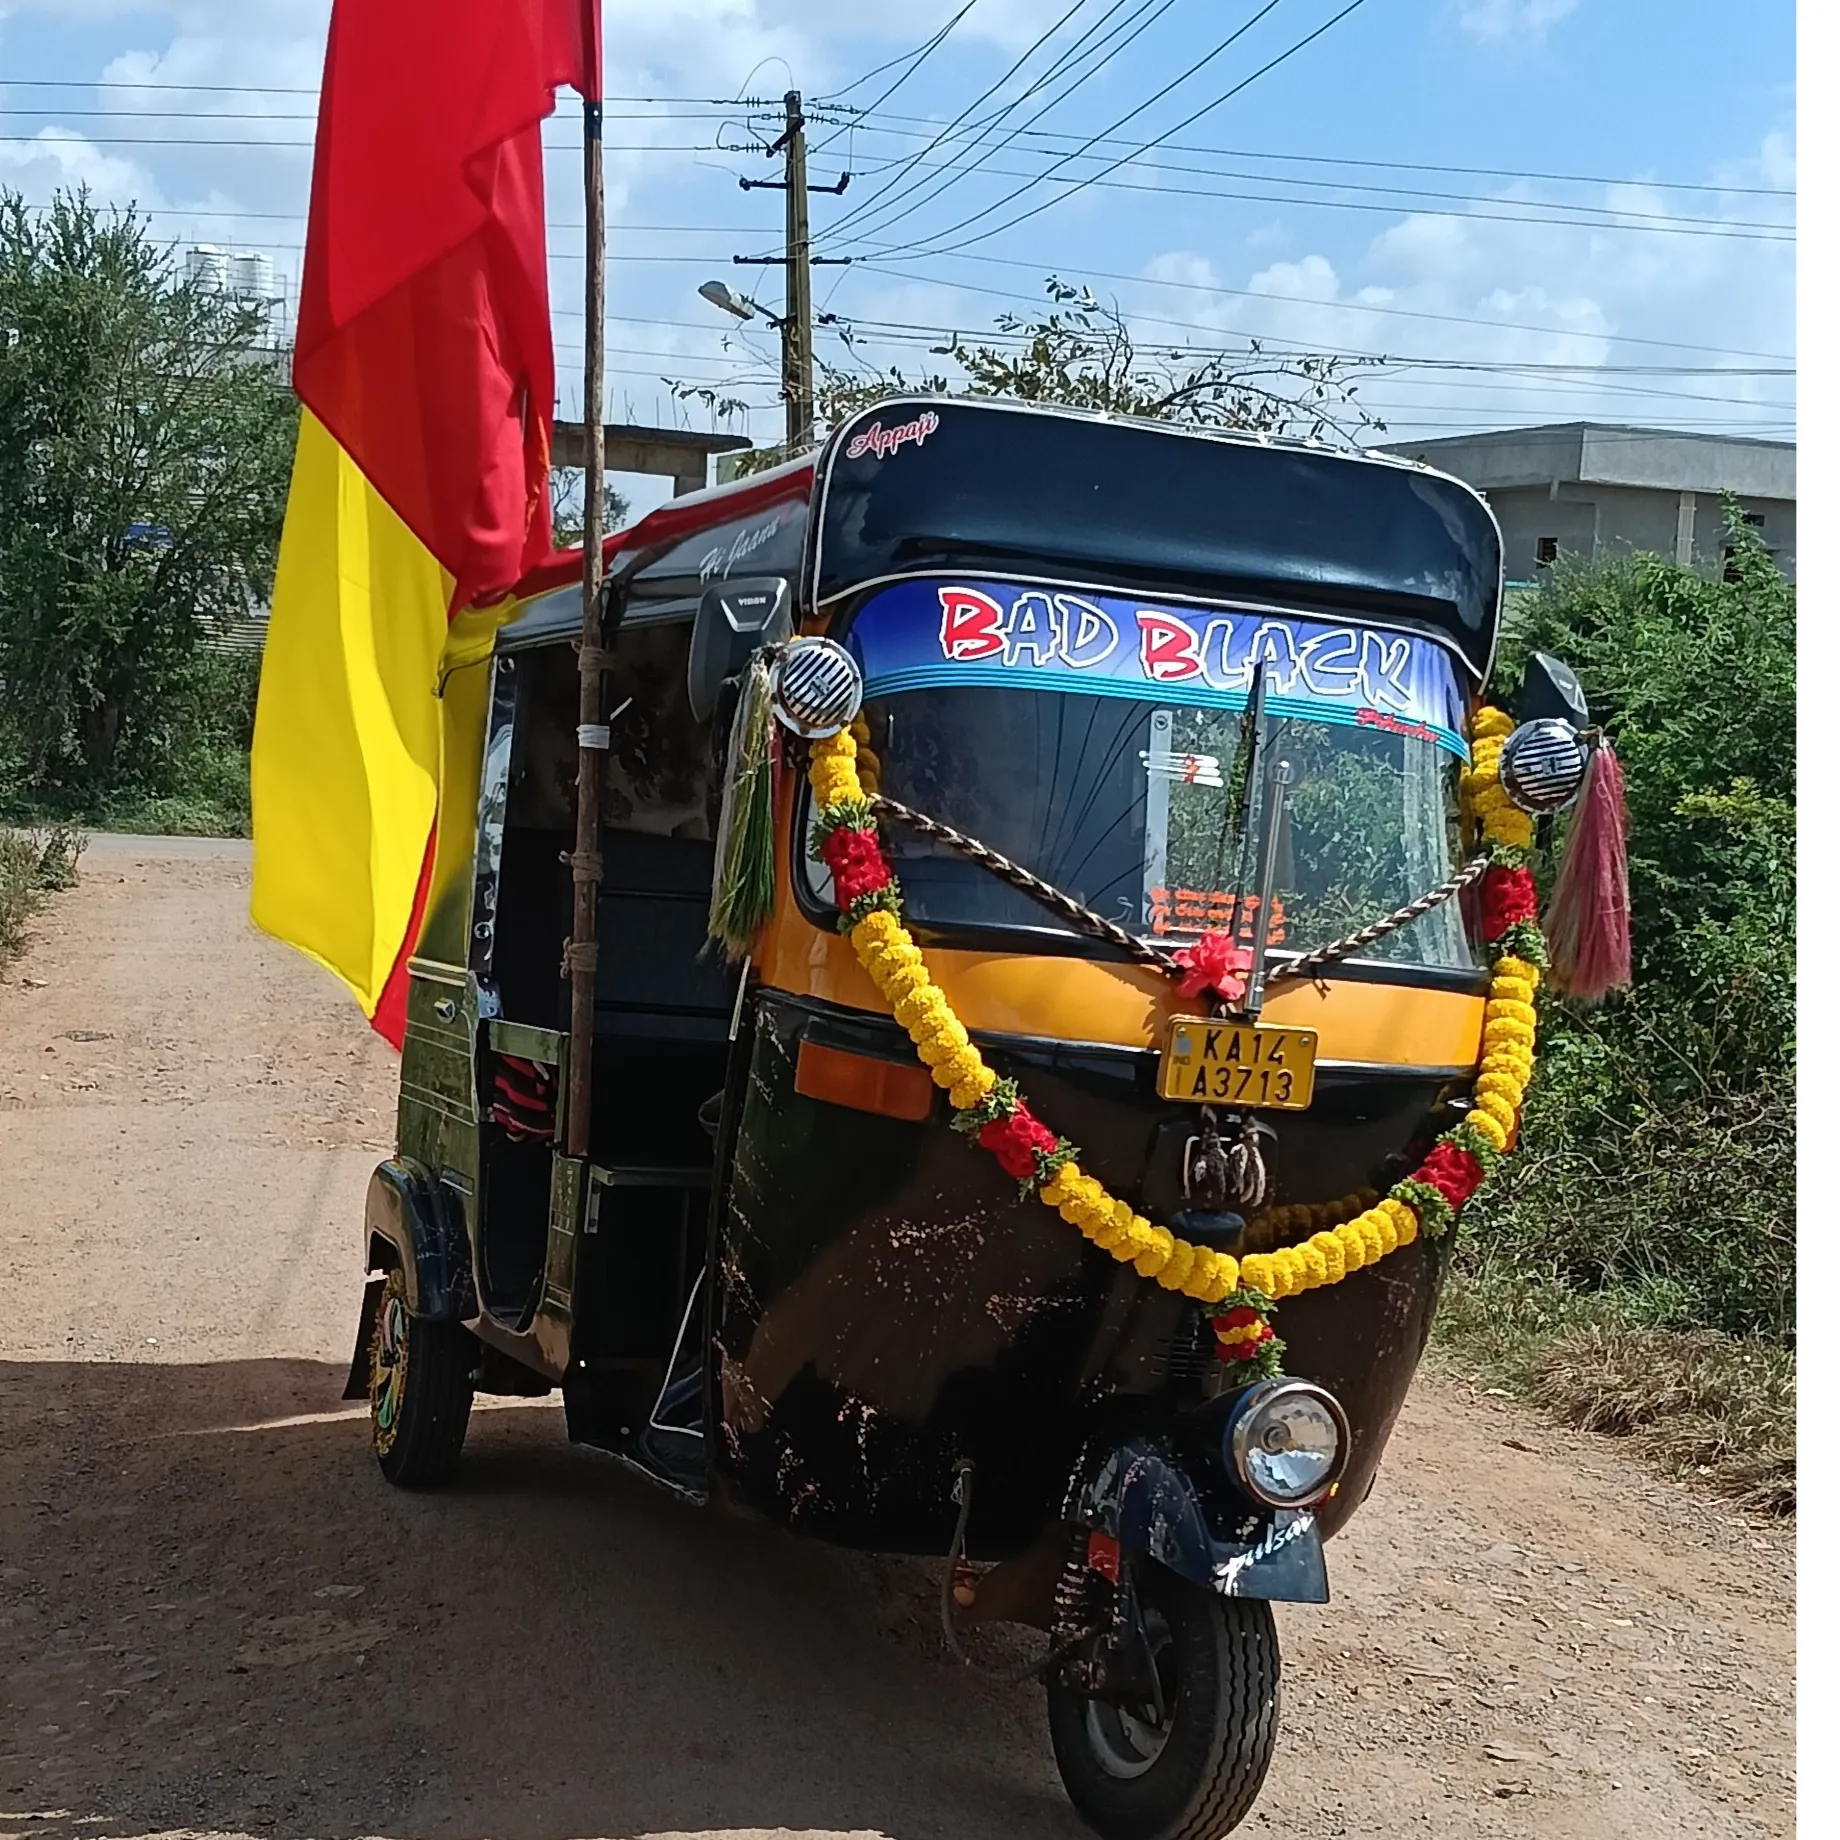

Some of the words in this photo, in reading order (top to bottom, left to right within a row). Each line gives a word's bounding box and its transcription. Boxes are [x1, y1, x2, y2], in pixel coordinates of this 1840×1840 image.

[846, 410, 939, 460] Appaji
[937, 586, 1118, 668] BAD
[1136, 610, 1414, 711] BLACK
[1192, 1065, 1293, 1101] A3713
